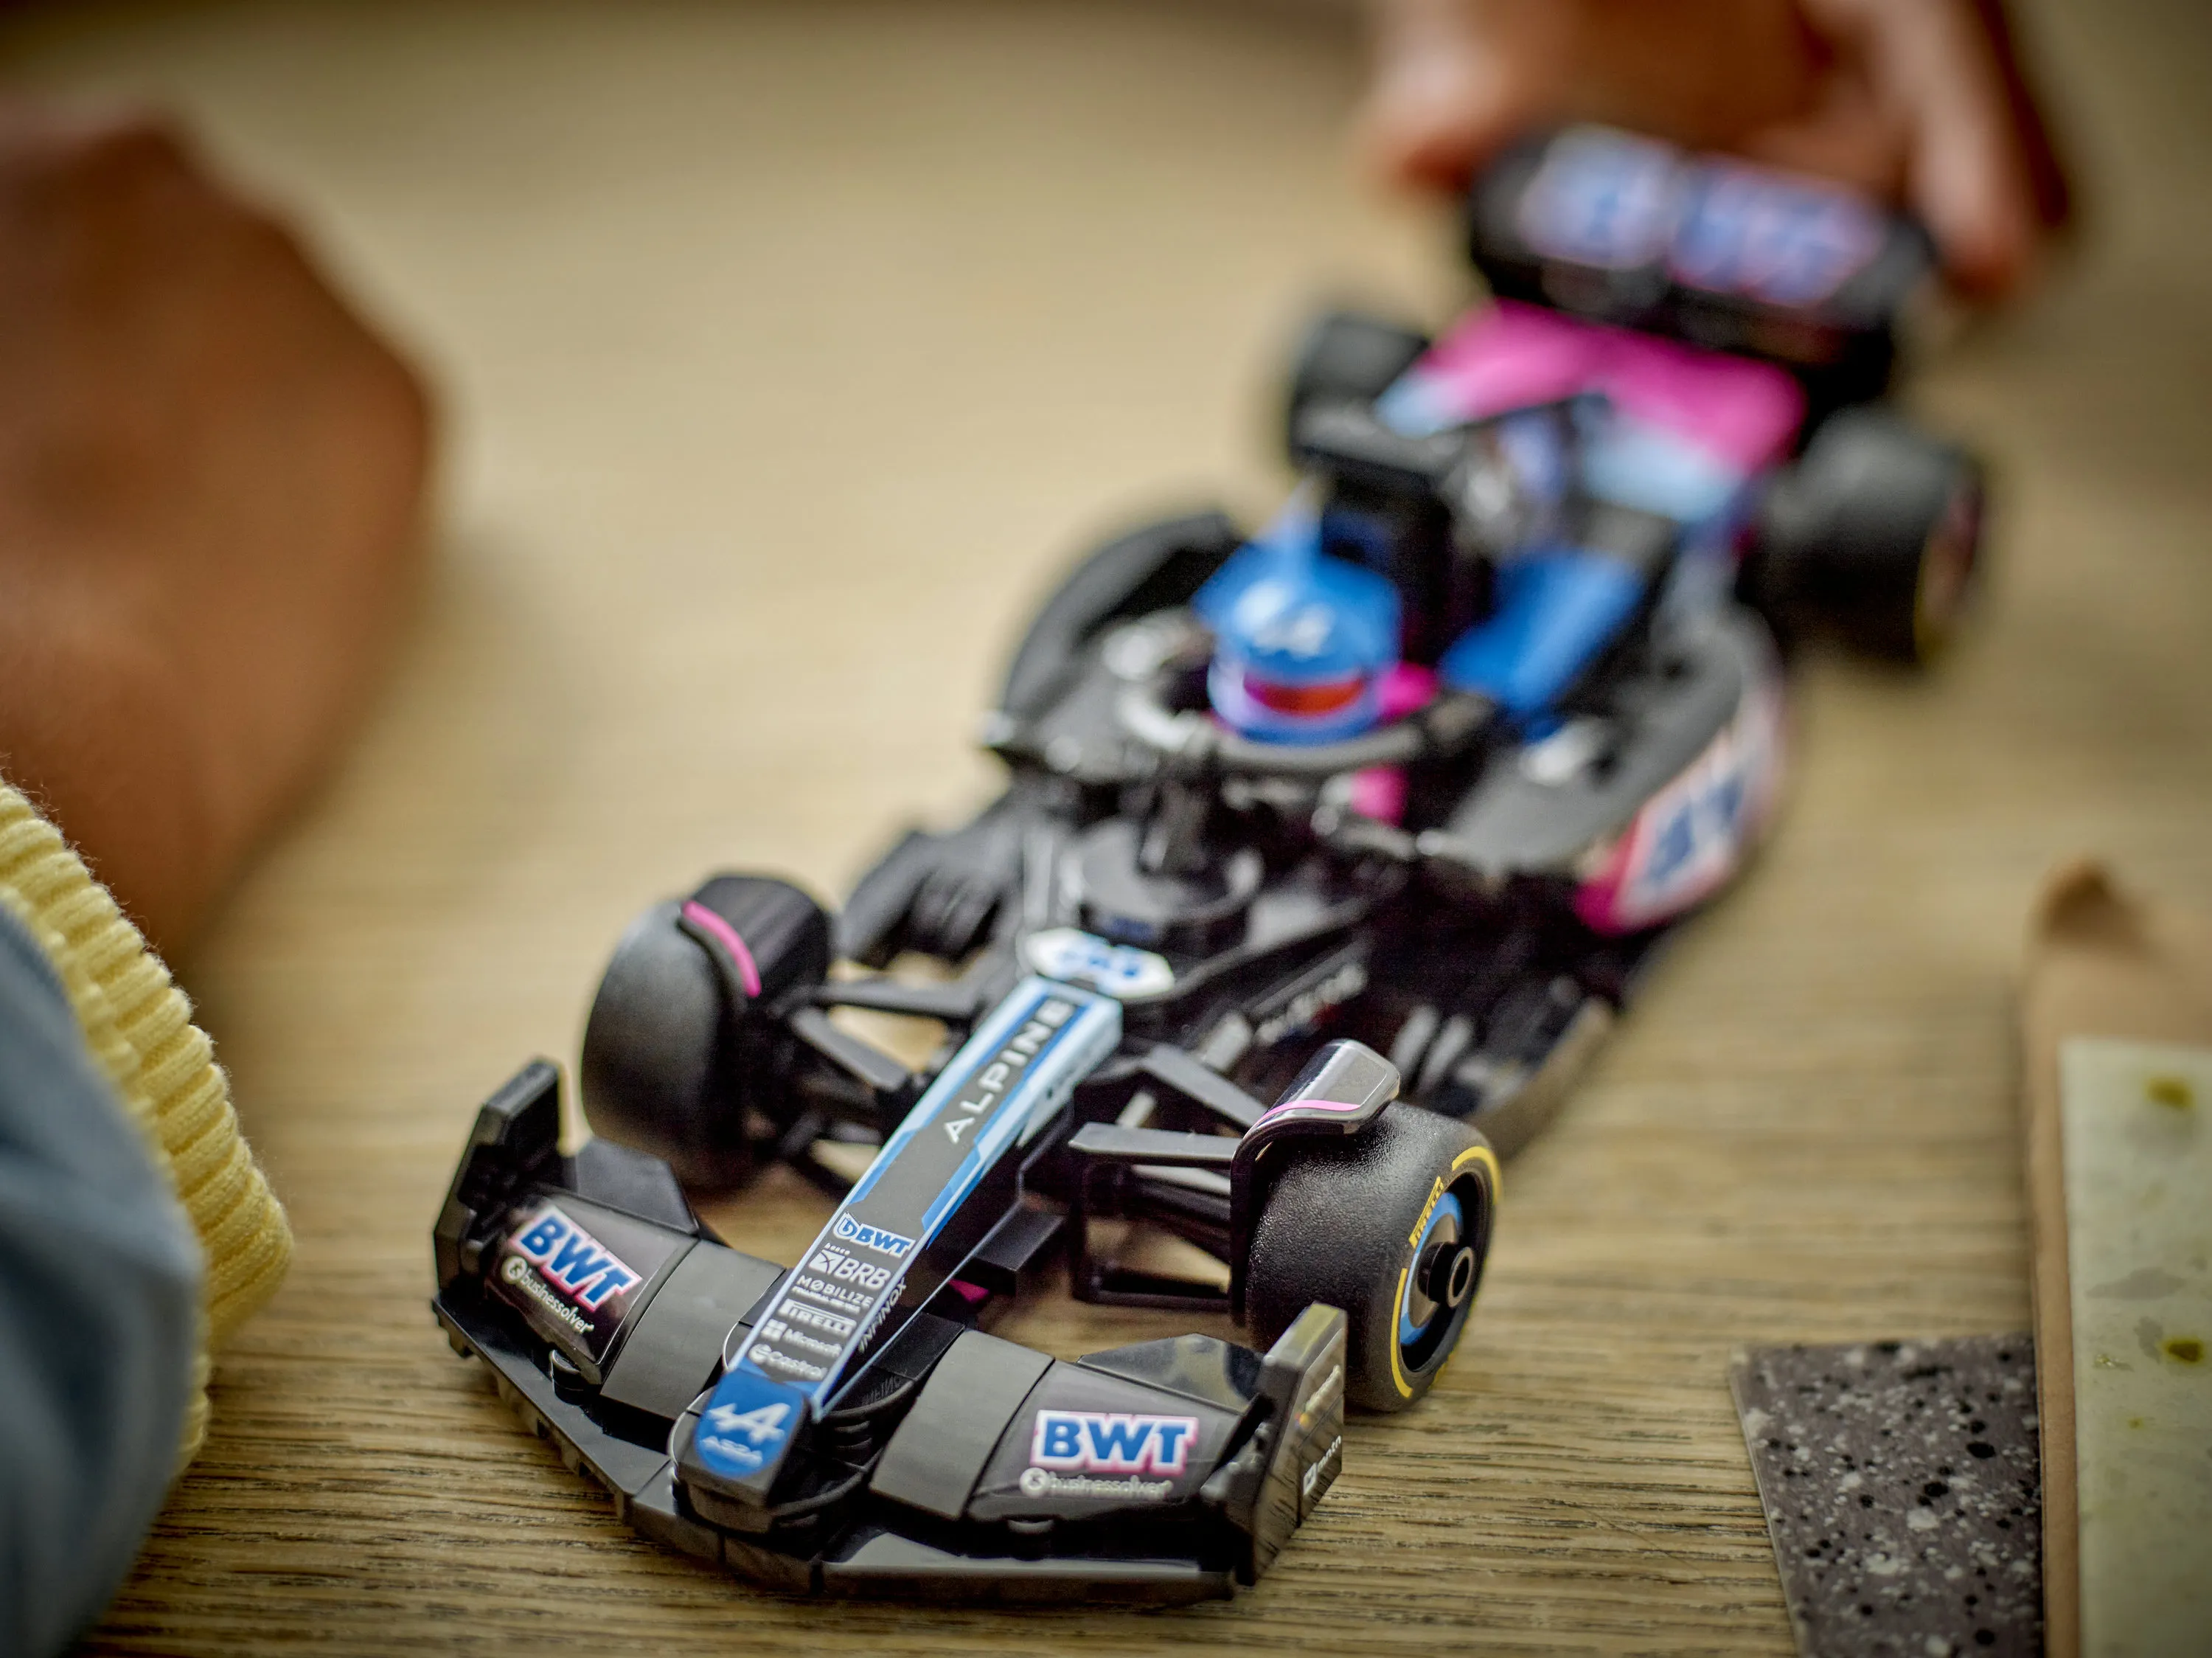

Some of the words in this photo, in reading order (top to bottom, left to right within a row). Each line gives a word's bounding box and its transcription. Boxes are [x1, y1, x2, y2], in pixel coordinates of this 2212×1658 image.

[944, 1000, 1076, 1143] ALPINE
[514, 1210, 640, 1309] BWT
[852, 1224, 915, 1257] BWT
[833, 1257, 891, 1290] BRB
[777, 1298, 857, 1338] PIRELLI
[1035, 1412, 1194, 1471] BWT
